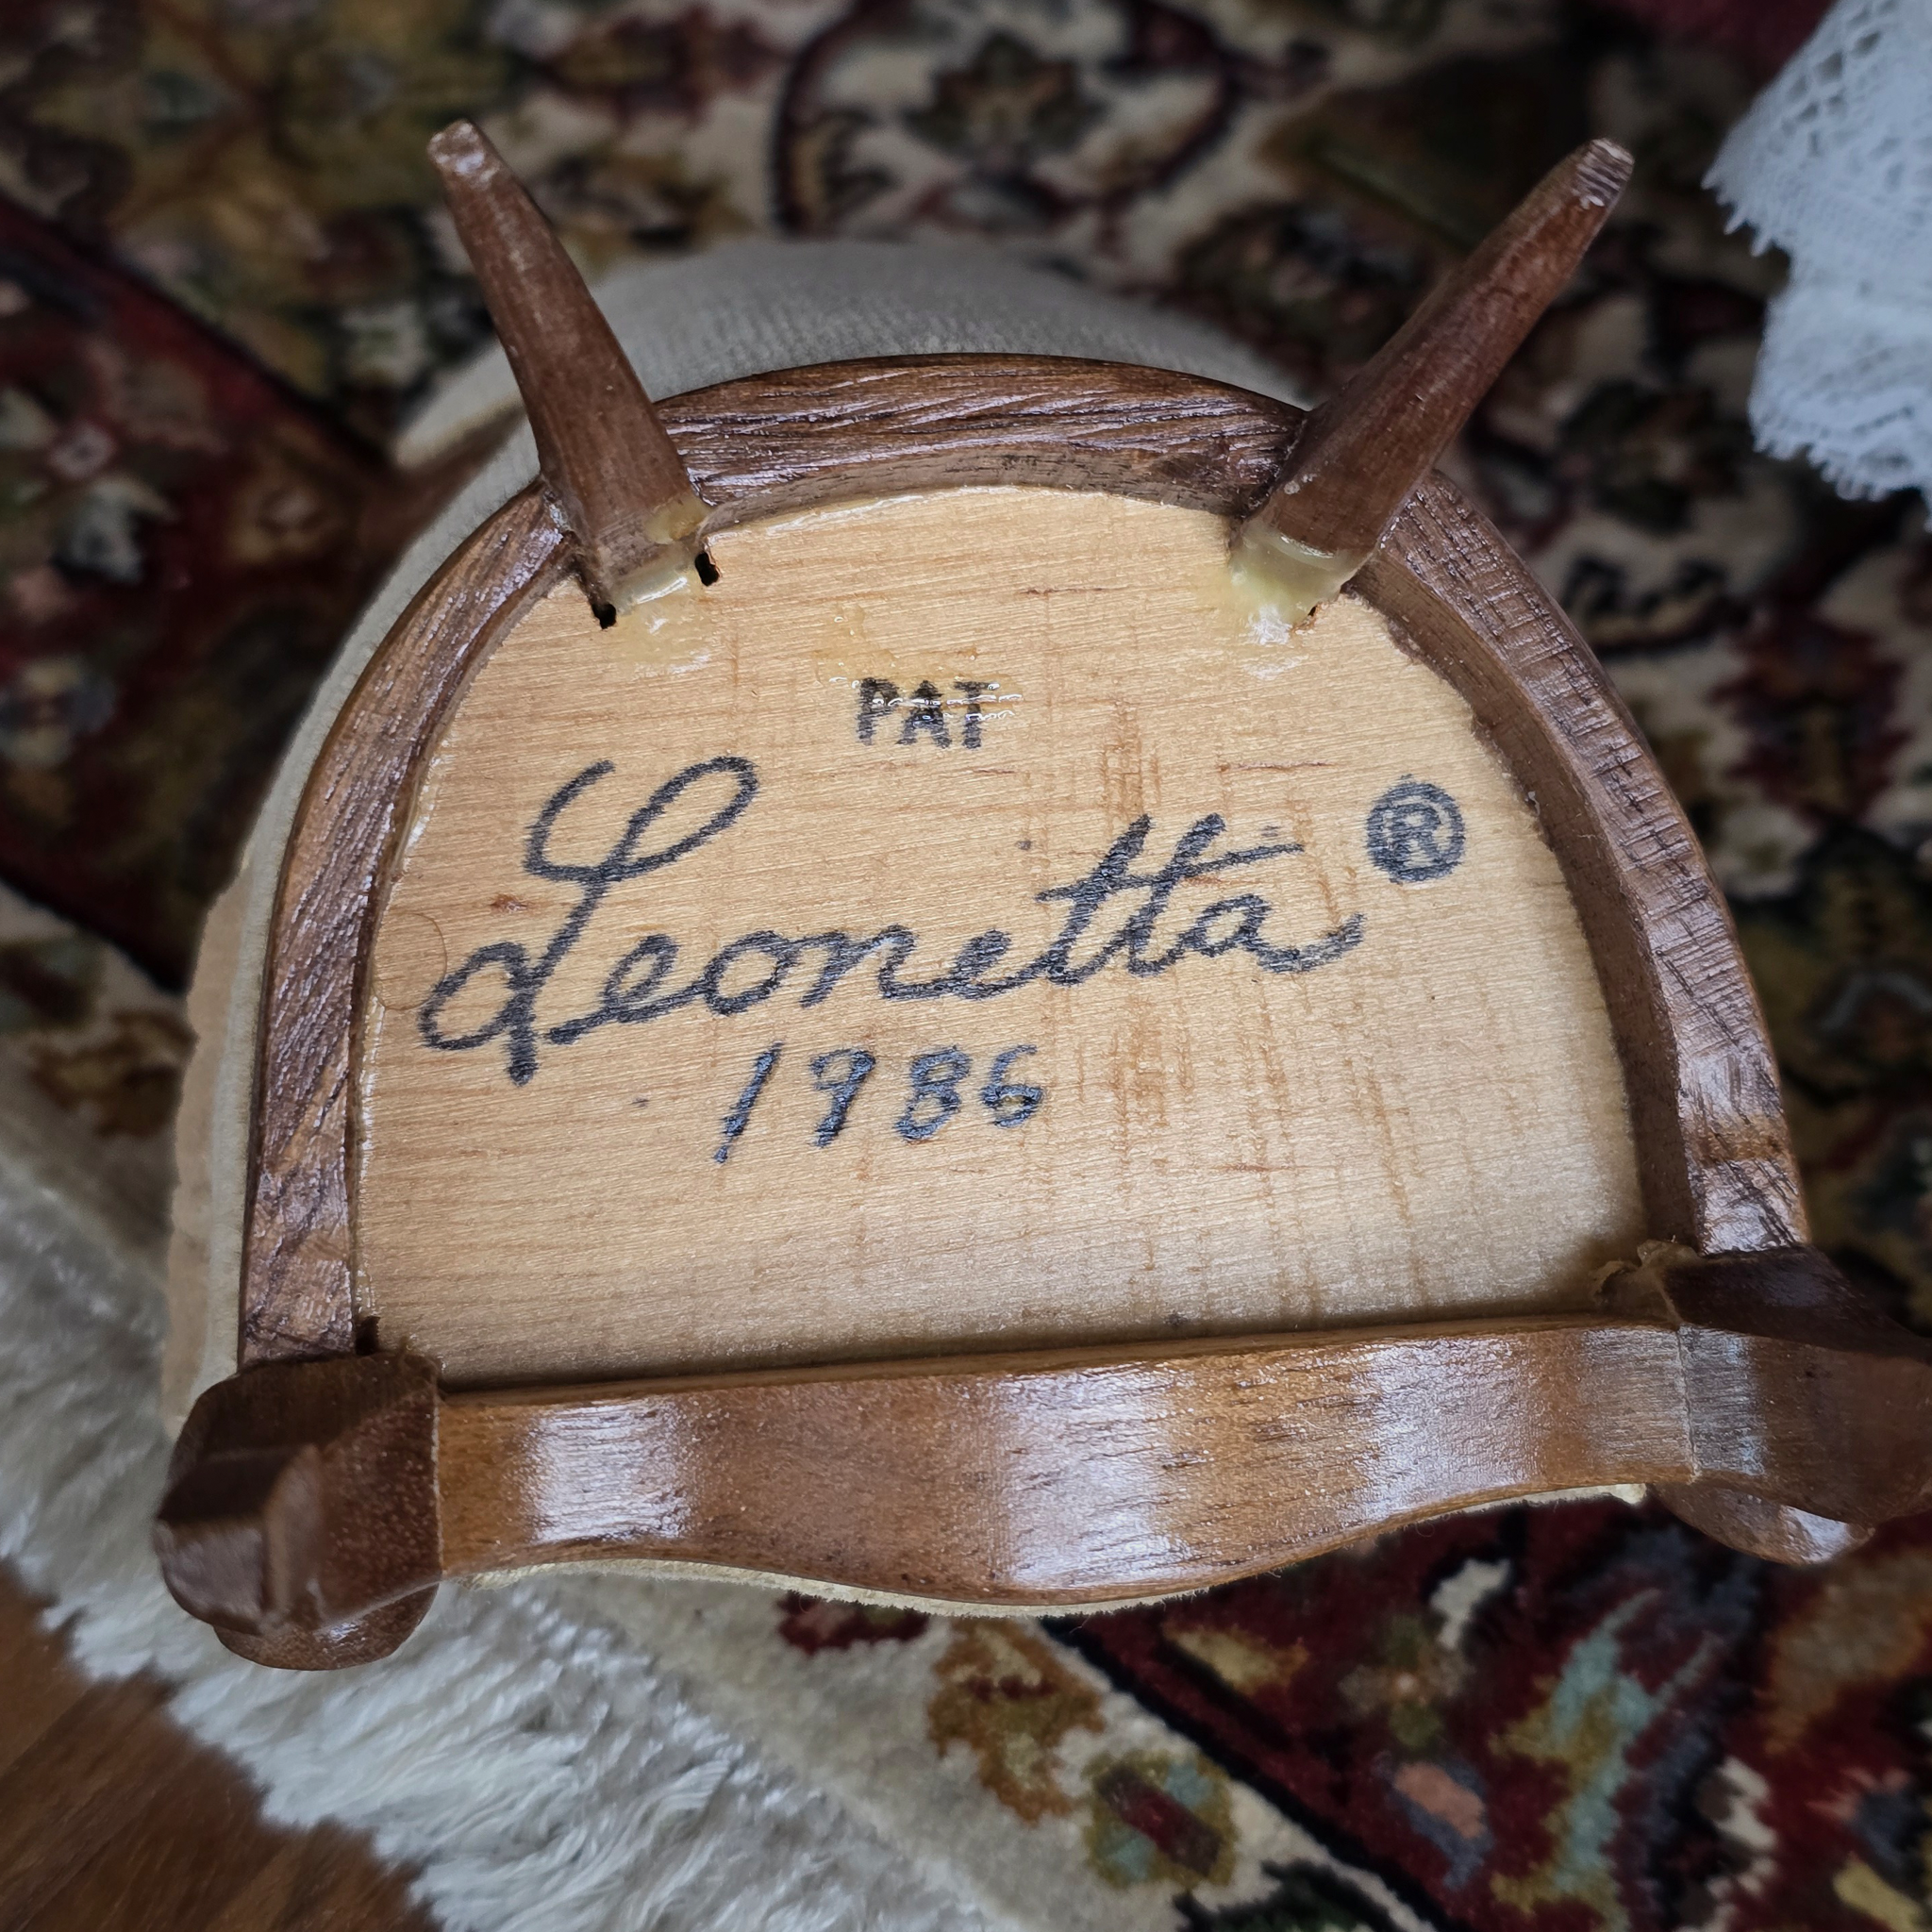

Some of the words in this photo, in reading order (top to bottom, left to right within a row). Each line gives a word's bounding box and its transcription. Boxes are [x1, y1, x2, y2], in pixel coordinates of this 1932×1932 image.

[856, 676, 996, 750] PAT
[417, 754, 1366, 1086] Leonetta
[712, 1041, 1045, 1165] 1986
